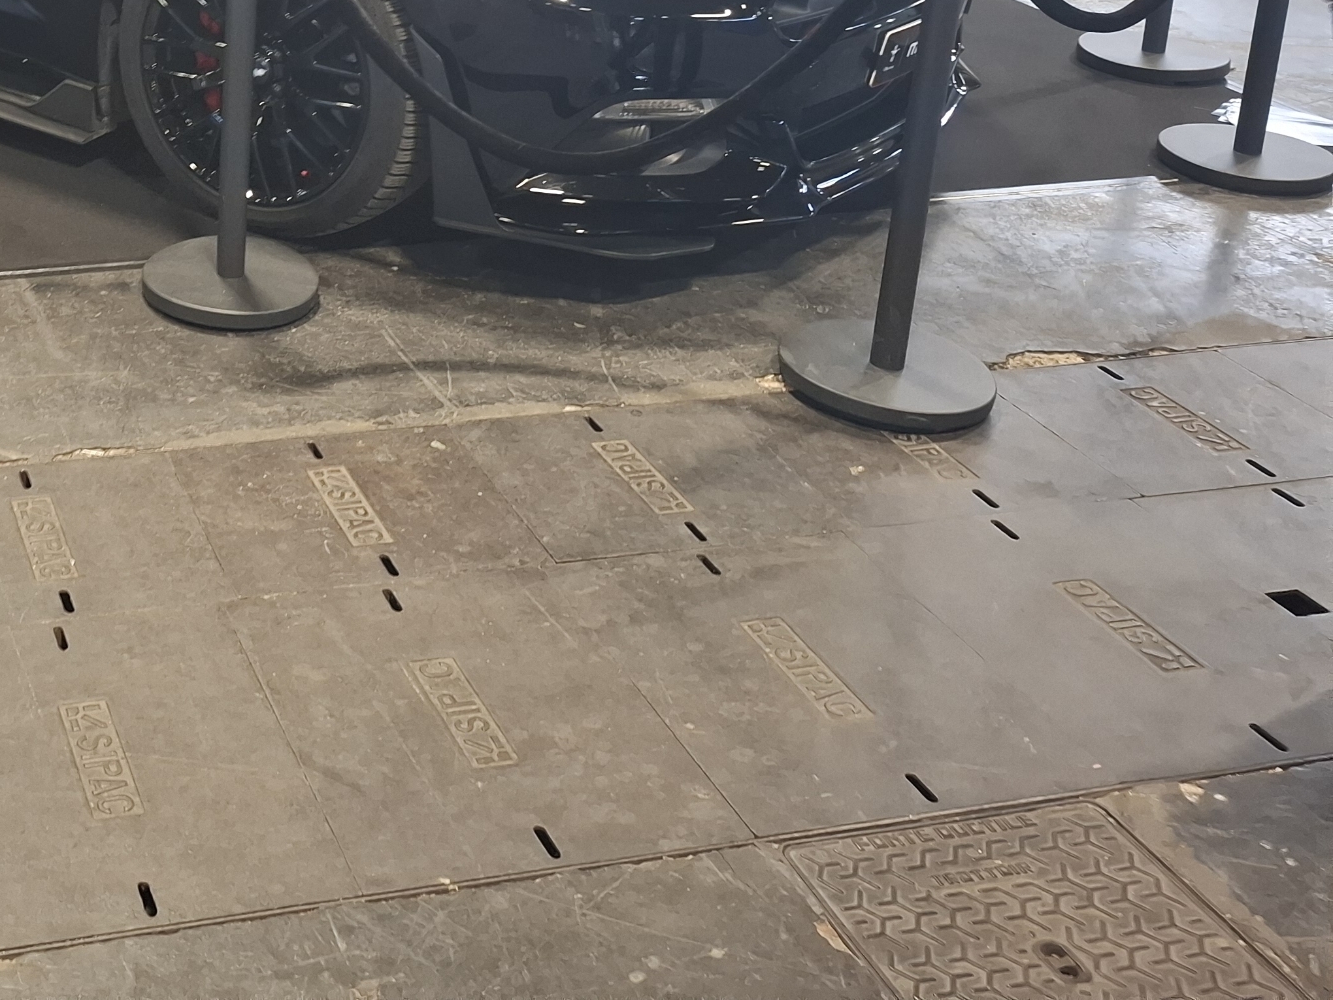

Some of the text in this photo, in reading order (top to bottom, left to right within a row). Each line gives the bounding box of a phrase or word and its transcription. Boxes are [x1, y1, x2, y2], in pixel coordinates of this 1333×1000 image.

[1130, 388, 1210, 433] SIPAC
[601, 442, 666, 491] SIPAC
[327, 485, 384, 542] SIPAC
[1063, 581, 1158, 644] SIPAC
[774, 647, 861, 718] SIPAC
[76, 733, 135, 815] SIPAC
[933, 813, 1038, 839] DUCTILE
[930, 862, 1035, 887] TROTTOIR
